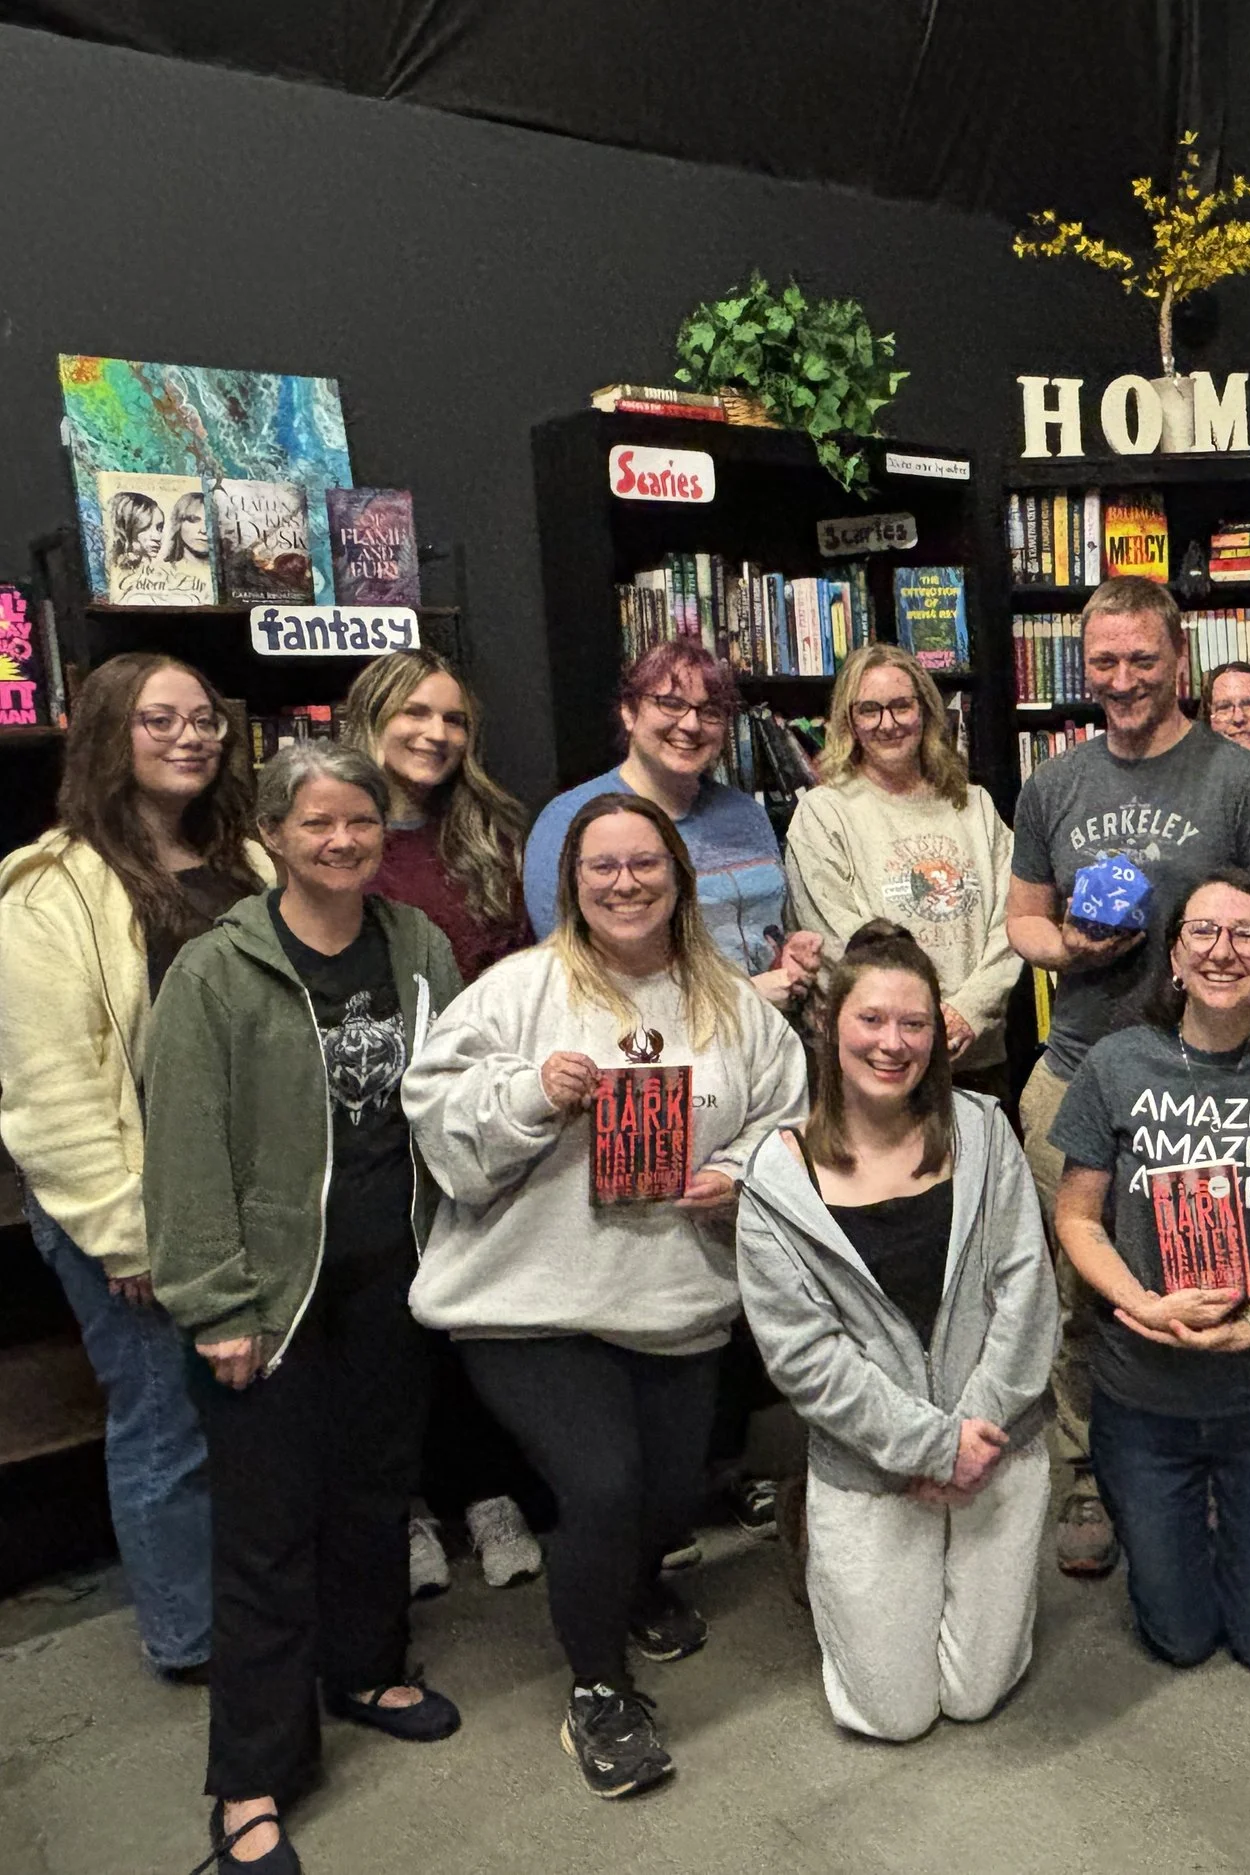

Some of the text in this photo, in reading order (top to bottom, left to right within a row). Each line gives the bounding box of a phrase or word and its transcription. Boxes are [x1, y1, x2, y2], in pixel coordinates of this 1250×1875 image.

[616, 451, 703, 500] Scaries
[341, 528, 405, 546] FLAME
[823, 517, 908, 550] Scaries
[1109, 534, 1166, 566] MERCY
[352, 561, 398, 580] FURY
[258, 608, 412, 652] fantasy
[1070, 809, 1199, 850] BERKELEY
[1112, 866, 1135, 882] 20
[596, 1090, 684, 1133] DARK
[596, 1131, 685, 1157] MATTER
